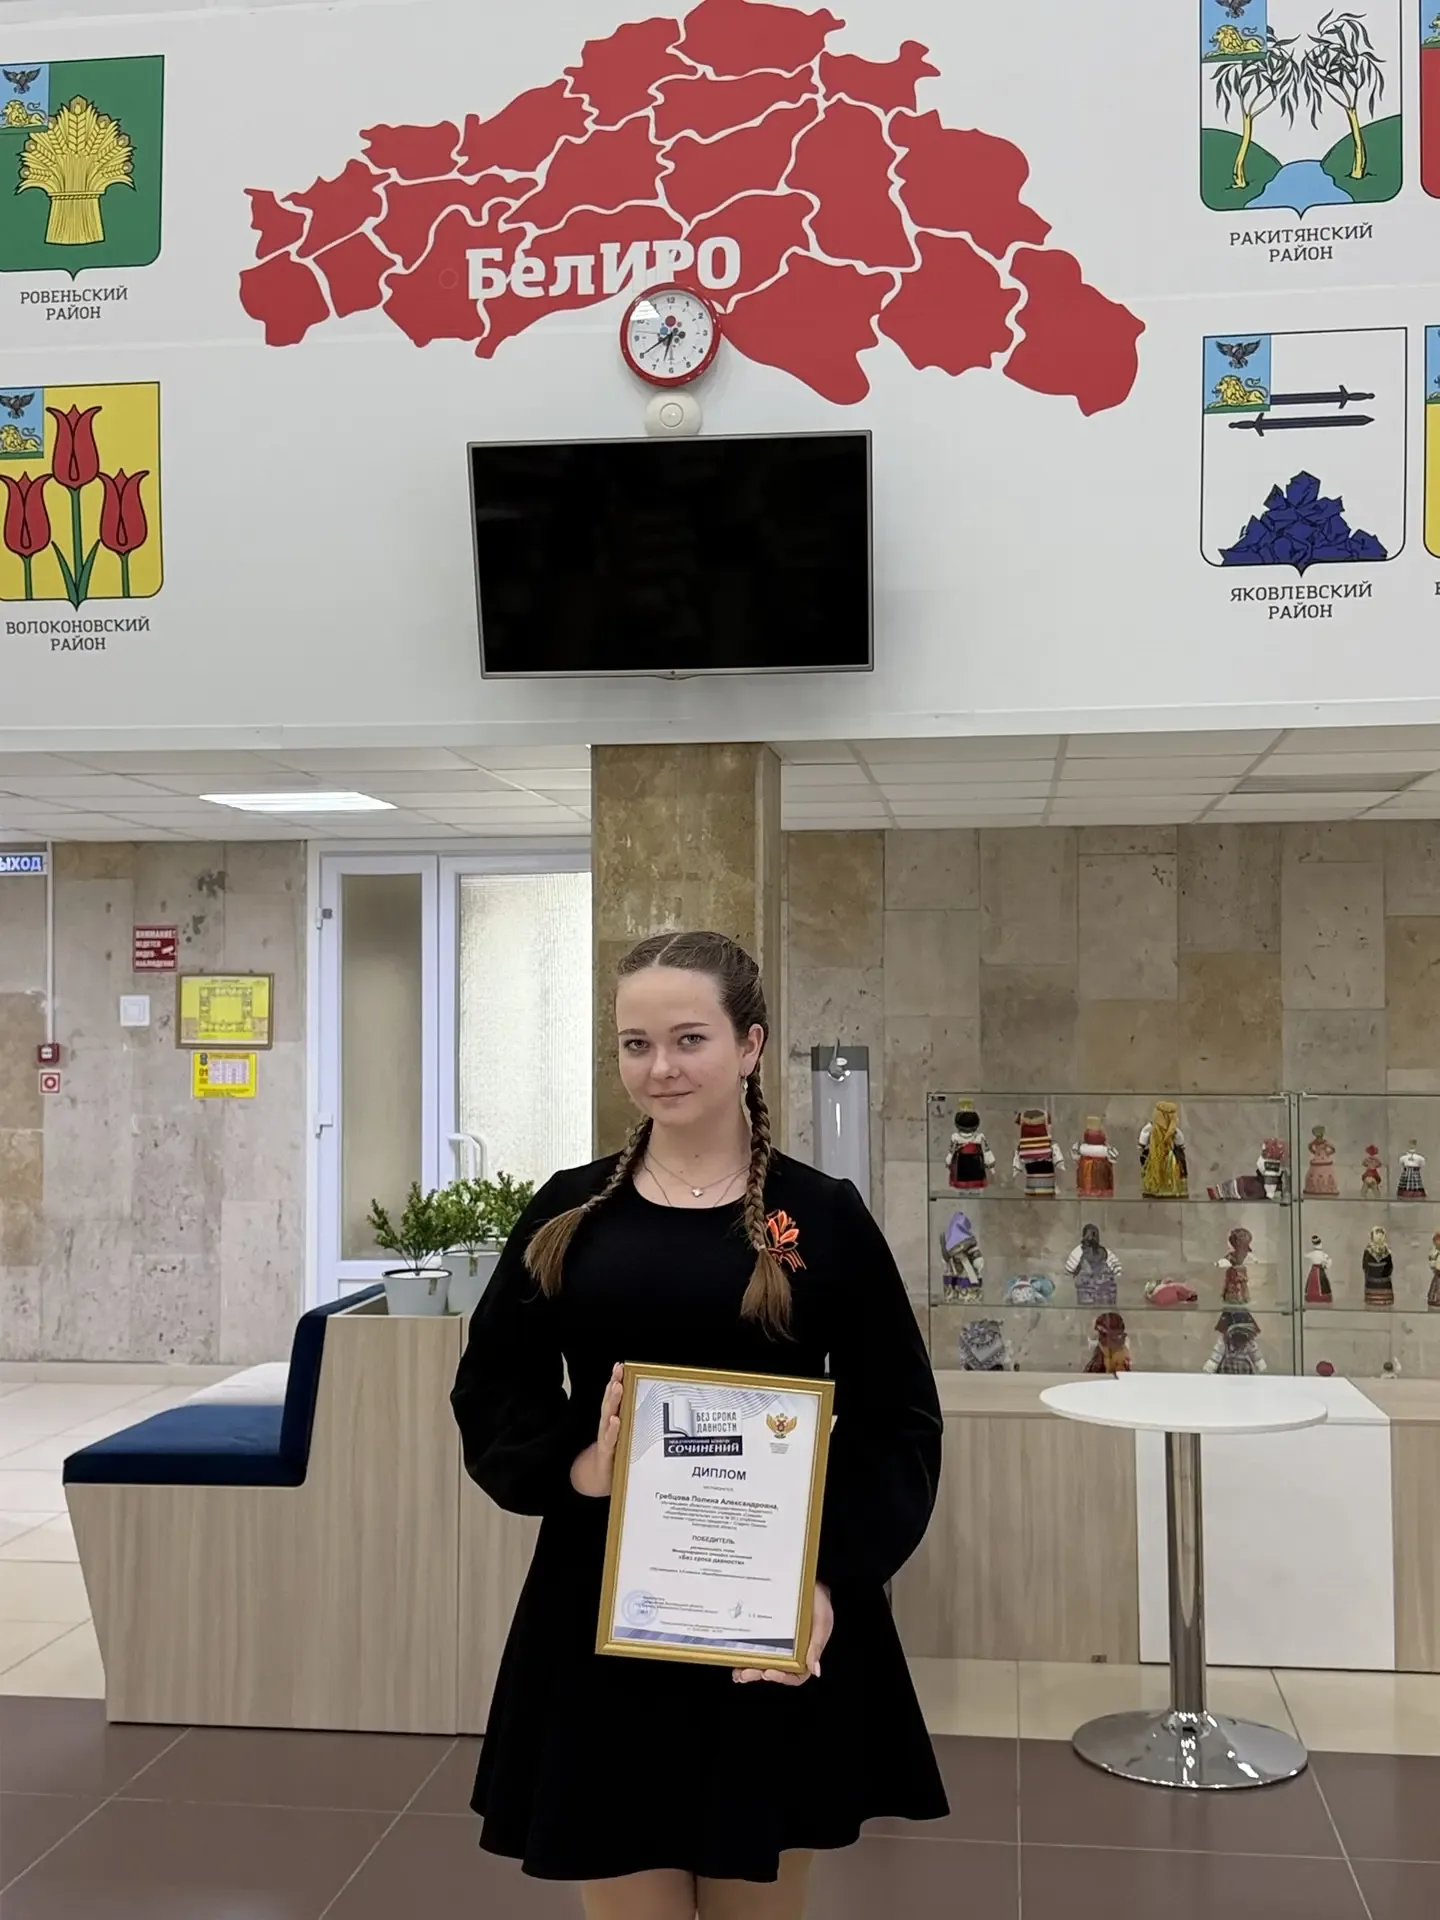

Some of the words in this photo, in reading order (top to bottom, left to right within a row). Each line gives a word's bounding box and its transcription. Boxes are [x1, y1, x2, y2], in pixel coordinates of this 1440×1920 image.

[1230, 222, 1373, 246] РАКИТЯНСКИЙ
[1269, 245, 1333, 262] РАЙОН
[466, 236, 741, 300] БелИРО
[20, 285, 128, 304] РОВЕНЬСКИЙ
[46, 305, 101, 320] РАЙОН
[1230, 580, 1372, 601] ЯКОВЛЕВСКИЙ
[1268, 602, 1333, 619] РАЙОН
[6, 616, 150, 635] ВОЛОКОНОВСКИЙ
[51, 635, 106, 651] РАЙОН
[0, 857, 41, 871] ЫХОД
[696, 1412, 710, 1422] БЕЗ
[712, 1411, 737, 1421] СРОКА
[696, 1422, 737, 1433] ДАВНОСТИ
[668, 1442, 739, 1454] СОЧИНЕНИЙ
[692, 1466, 746, 1480] ДИПЛОМ
